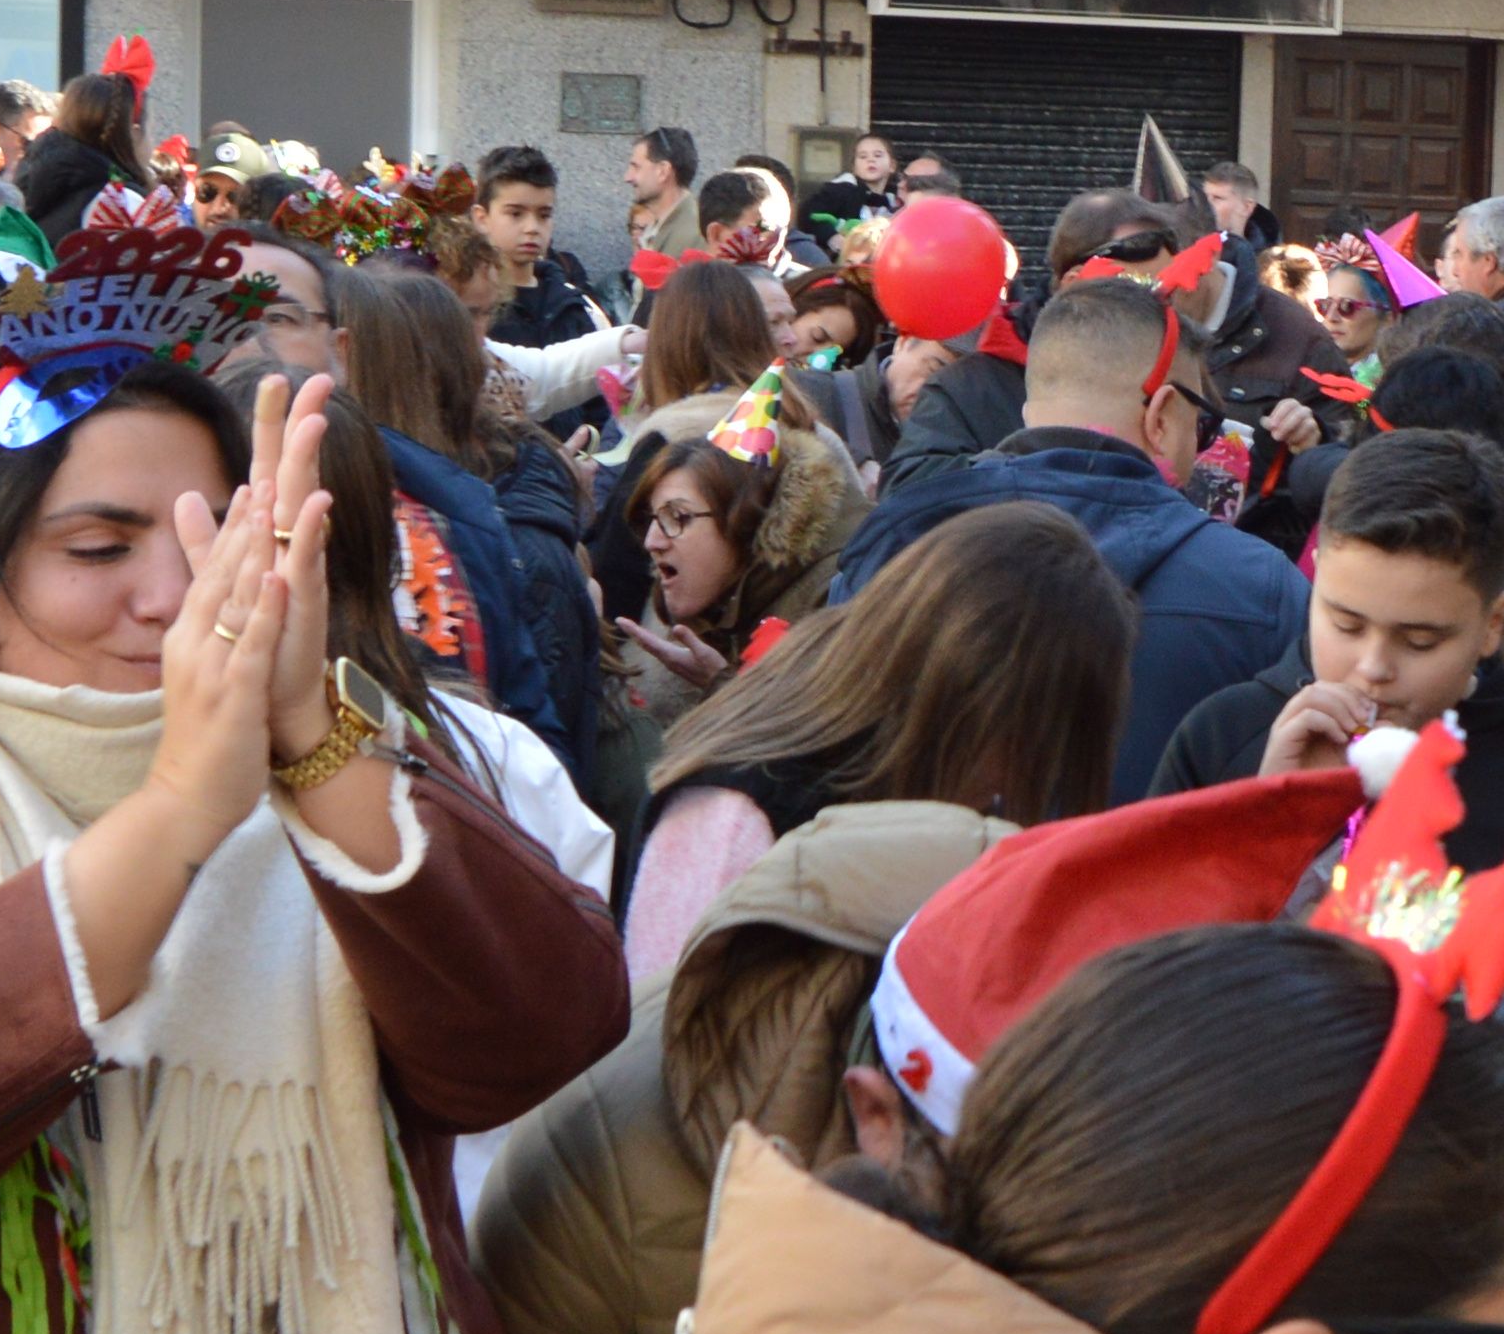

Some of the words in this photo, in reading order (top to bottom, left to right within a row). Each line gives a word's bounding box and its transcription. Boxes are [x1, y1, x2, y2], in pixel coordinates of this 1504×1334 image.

[47, 227, 253, 283] 2026
[60, 273, 234, 310] FELIZ
[116, 299, 258, 351] NUEVO
